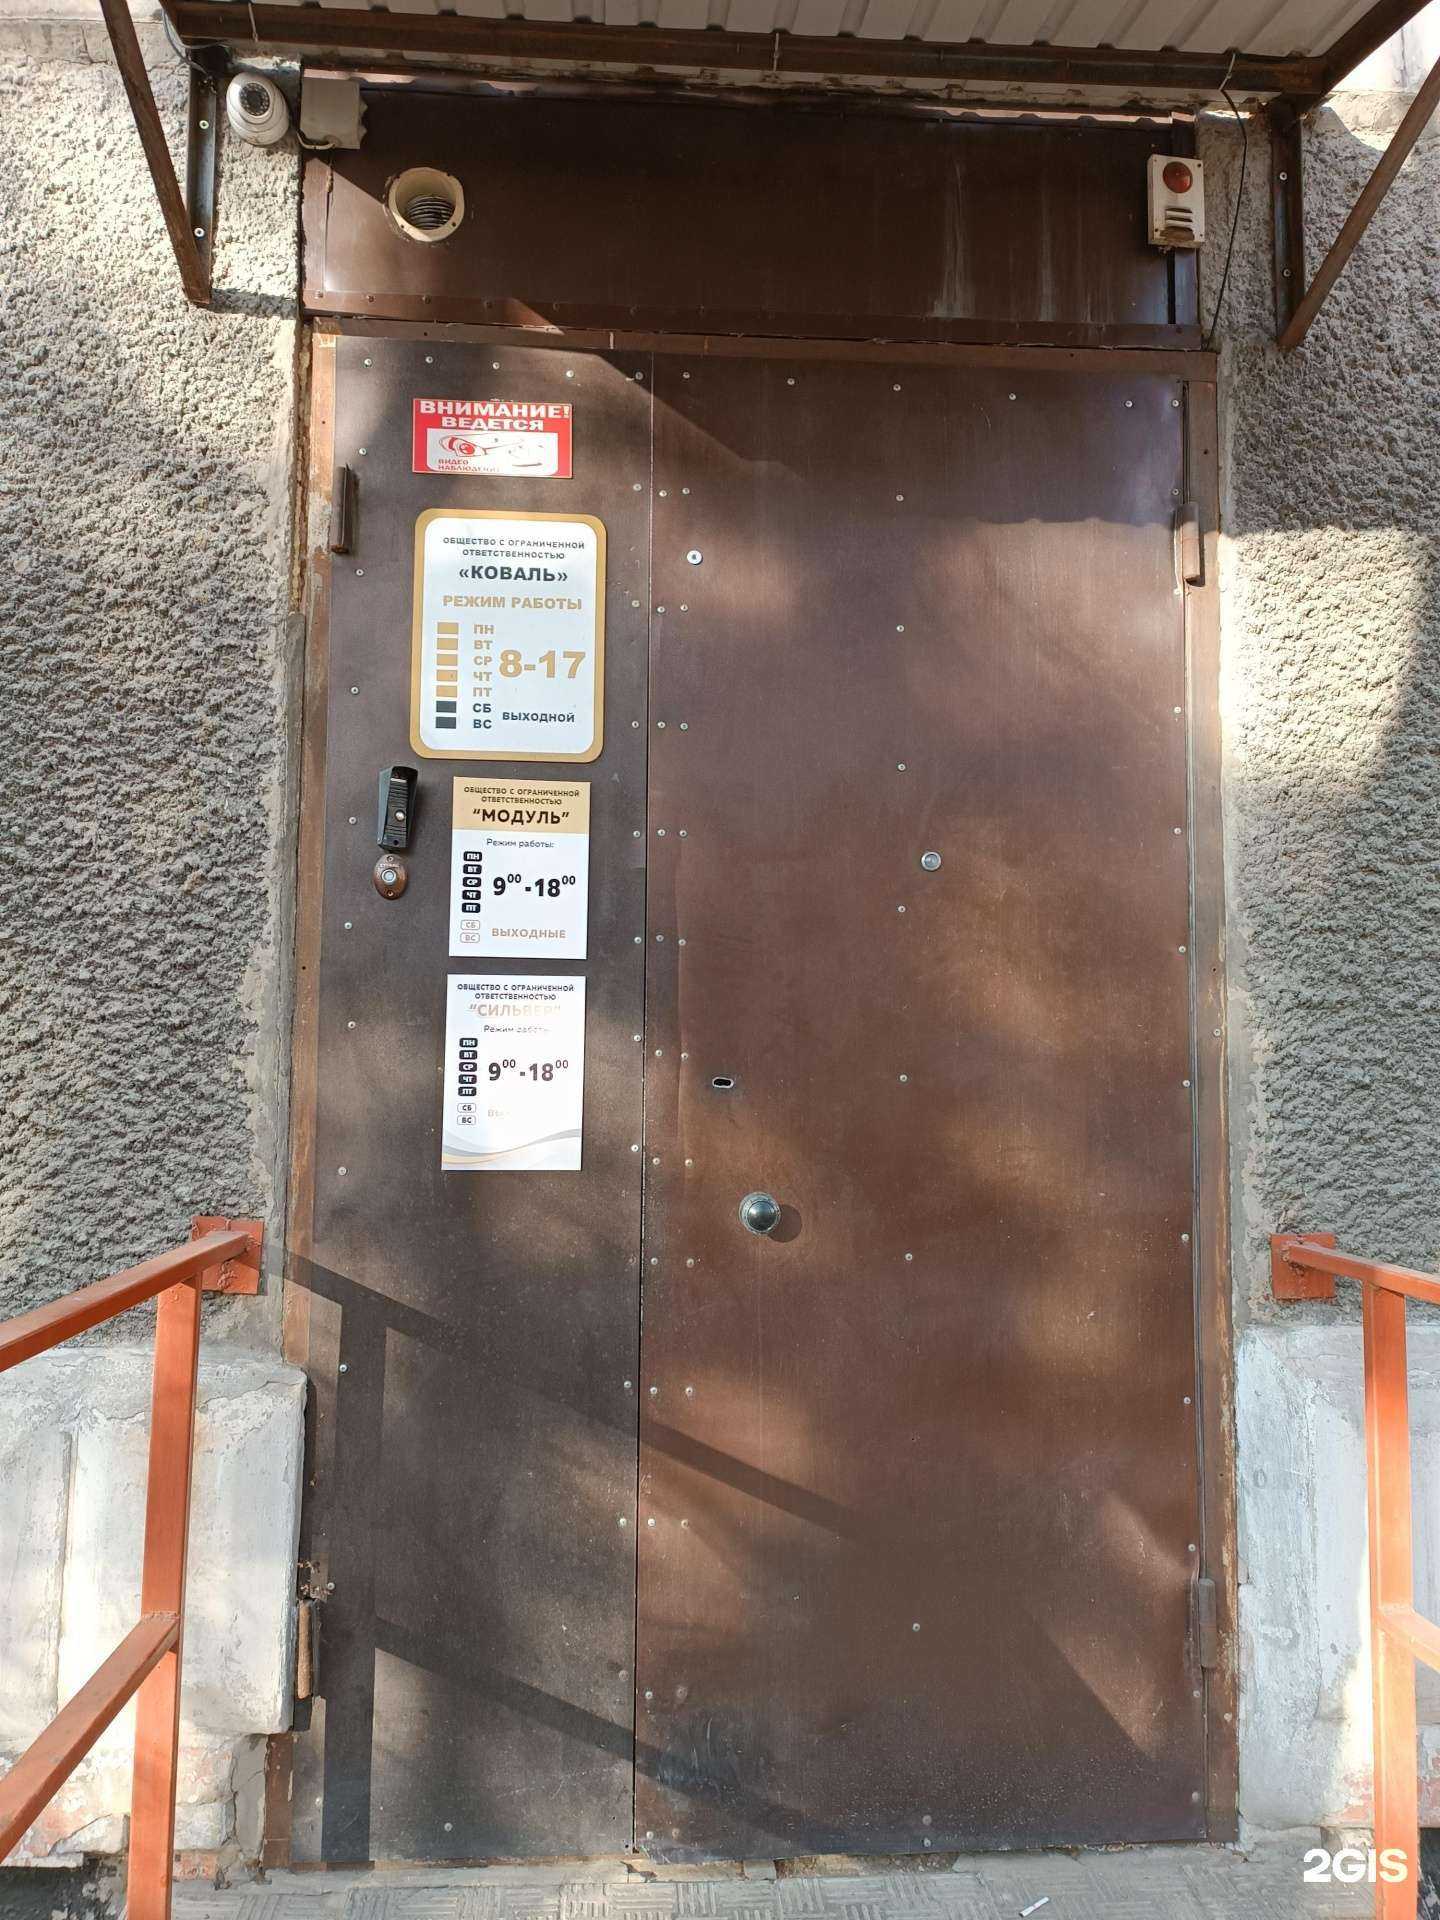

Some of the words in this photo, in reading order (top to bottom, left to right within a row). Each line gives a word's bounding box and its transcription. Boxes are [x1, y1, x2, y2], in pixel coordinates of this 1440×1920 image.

[420, 400, 569, 418] ВНИМАНИЕ!
[441, 416, 544, 431] ВЕДЕТСЯ
[443, 537, 496, 546] ОБЩЕСТВО
[508, 539, 585, 549] ОГРАНИЧЕННОЙ
[462, 549, 565, 560] ОТВЕТСТВЕННОСТЬЮ
[459, 565, 568, 582] «КОВАЛЬ»
[443, 595, 505, 608] РЕЖИМ
[511, 597, 582, 610] РАБОТЫ
[473, 624, 494, 634] ПН
[473, 640, 493, 650] ВТ
[473, 656, 493, 666] СР
[499, 649, 586, 679] 8-17
[473, 671, 492, 681] ЧТ
[472, 687, 492, 697] ПТ
[472, 703, 492, 713] СБ
[473, 719, 492, 729] ВС
[463, 786, 507, 795] ОБЩЕСТВО
[517, 788, 580, 797] ОГРАНИЧЕННОЙ
[481, 796, 562, 805] ОТВЕТСТВЕННОСТЬЮ
[486, 838, 516, 847] Режим
[519, 840, 554, 849] работы:
[491, 927, 566, 939] ВЫХОДНЫЕ
[457, 983, 501, 991] ОБЩЕСТВО
[511, 983, 574, 992] ОГРАНИЧЕННОЙ
[475, 993, 557, 1001] ОТВЕТСТВЕННОСТЬЮ
[483, 1025, 514, 1033] Режим
